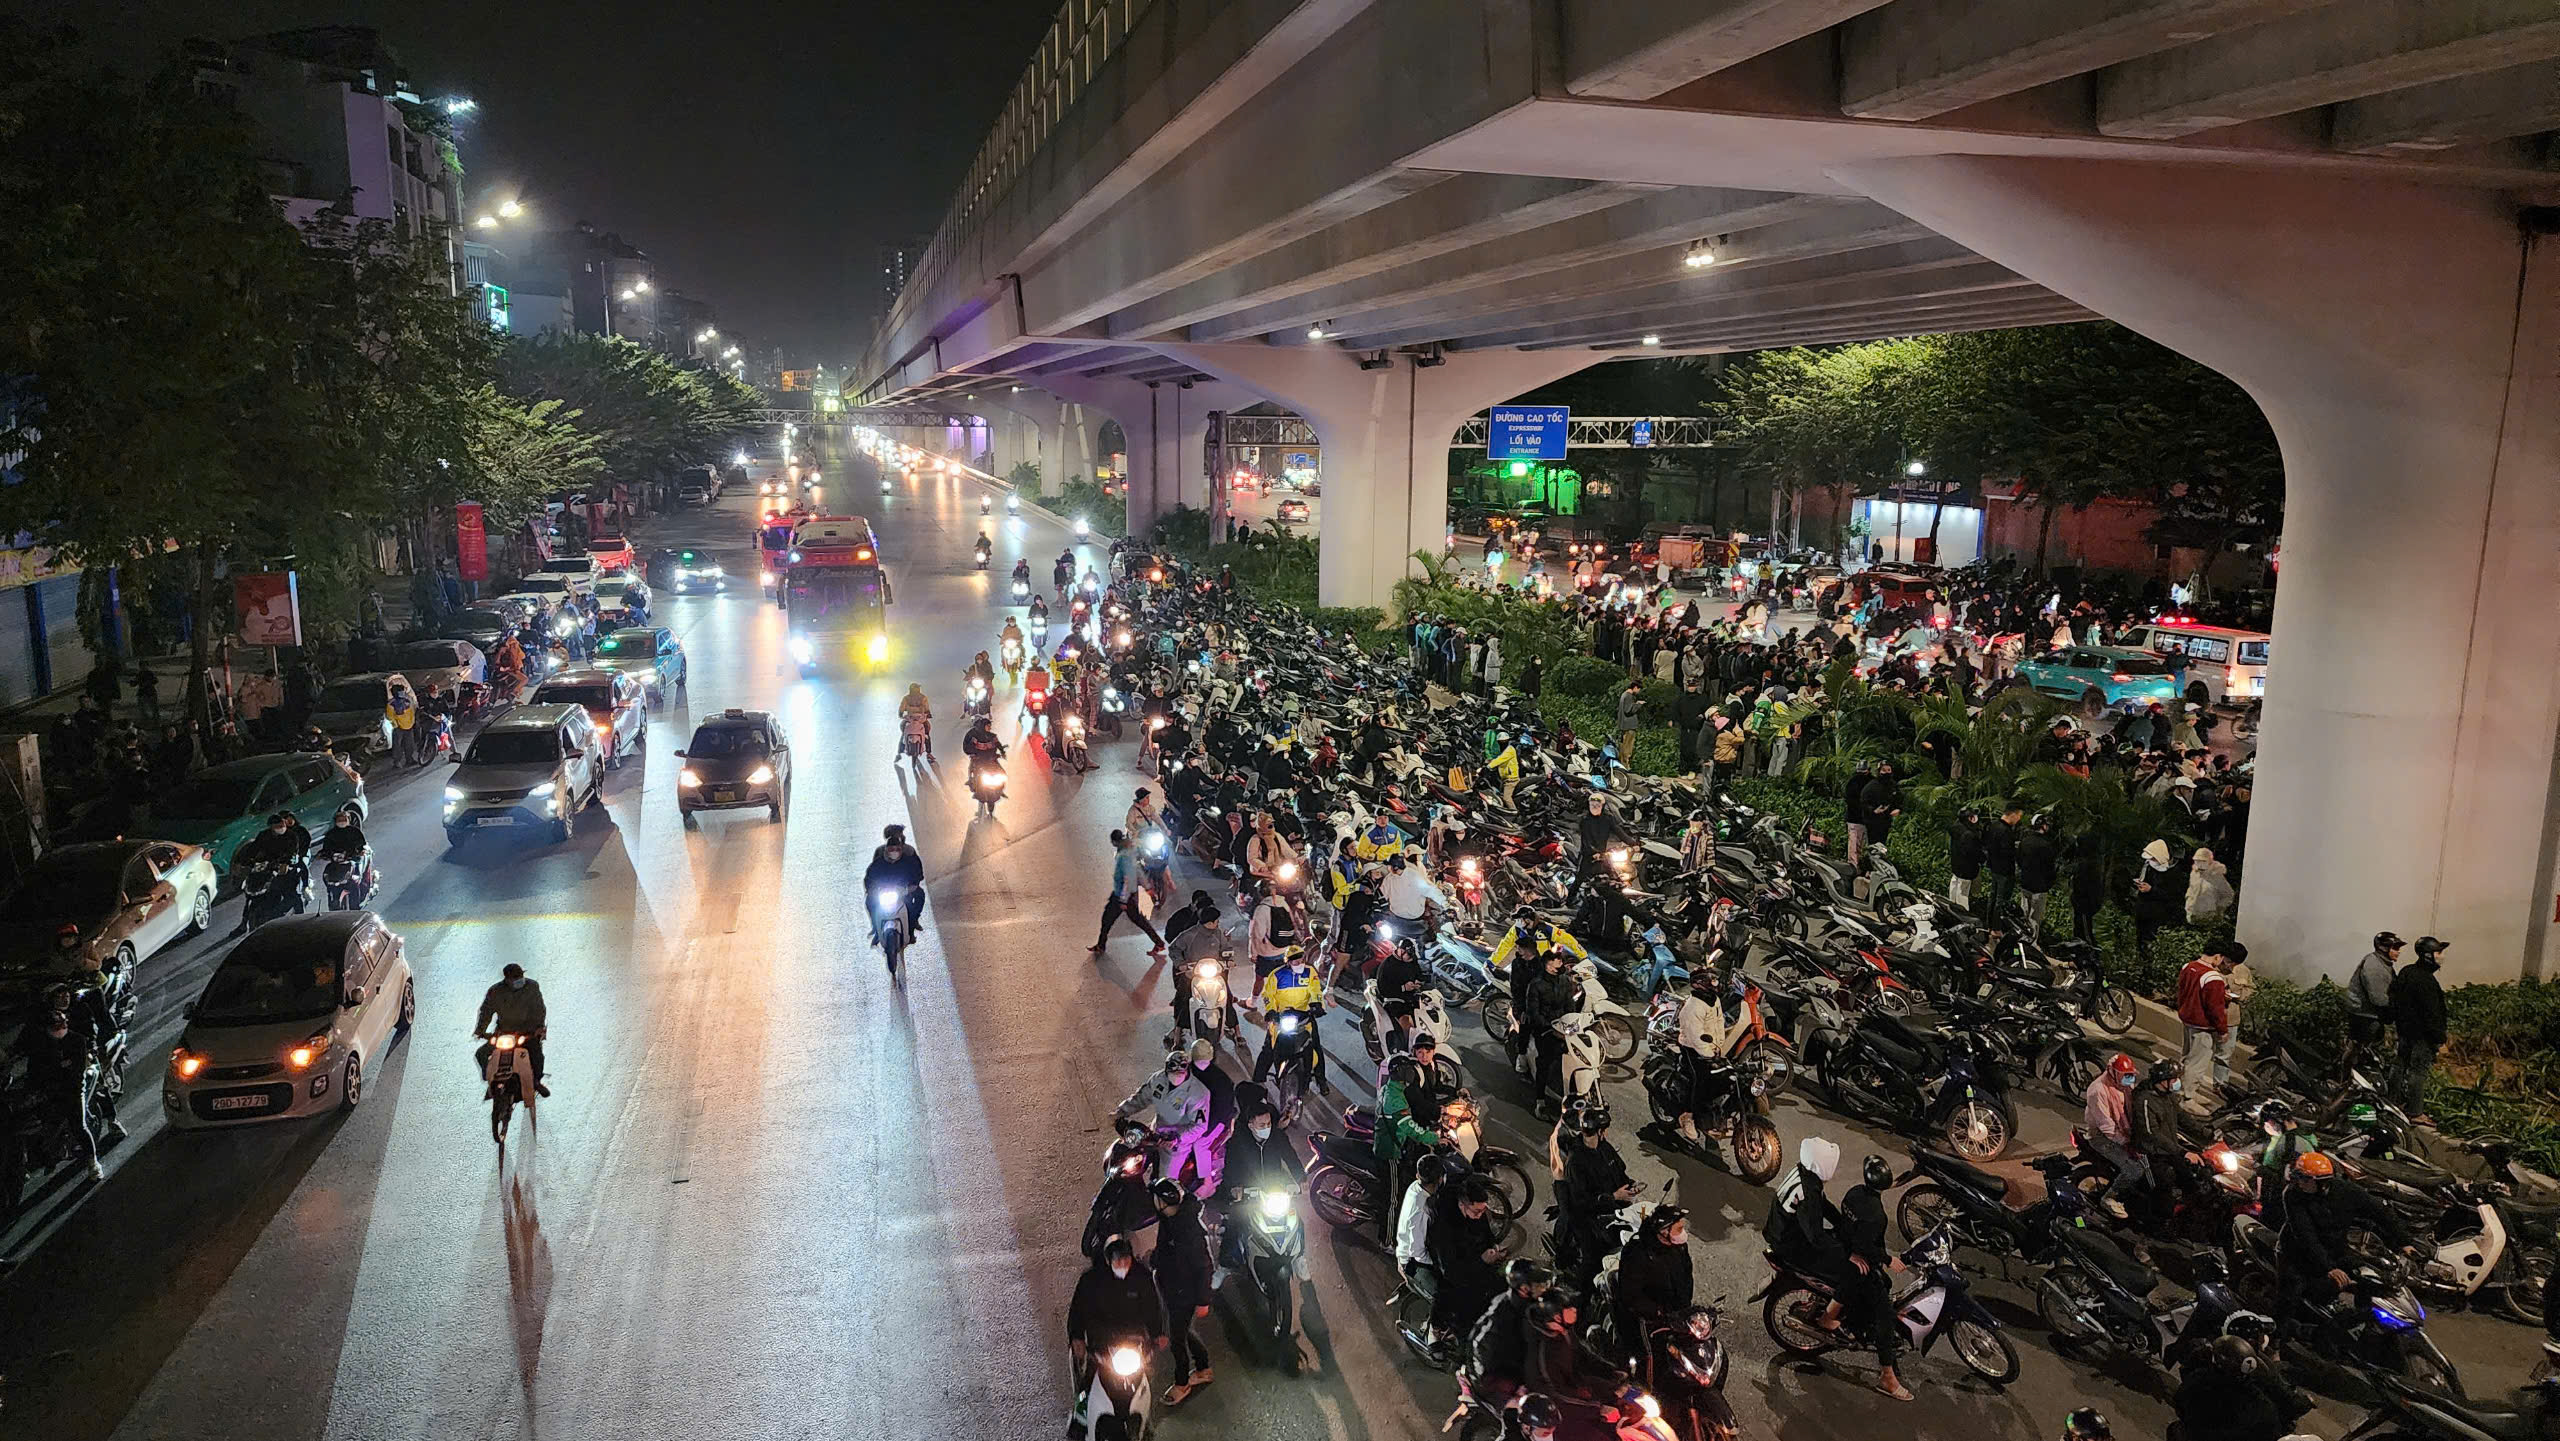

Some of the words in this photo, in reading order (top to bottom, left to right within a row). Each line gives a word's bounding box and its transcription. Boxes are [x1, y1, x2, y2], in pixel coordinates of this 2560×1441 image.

[1495, 411, 1524, 422] ĐƯỜNG
[1527, 414, 1544, 422] CAO
[1547, 411, 1563, 423] TỐC
[1509, 434, 1523, 445] LỐI
[1526, 434, 1541, 444] VÀO
